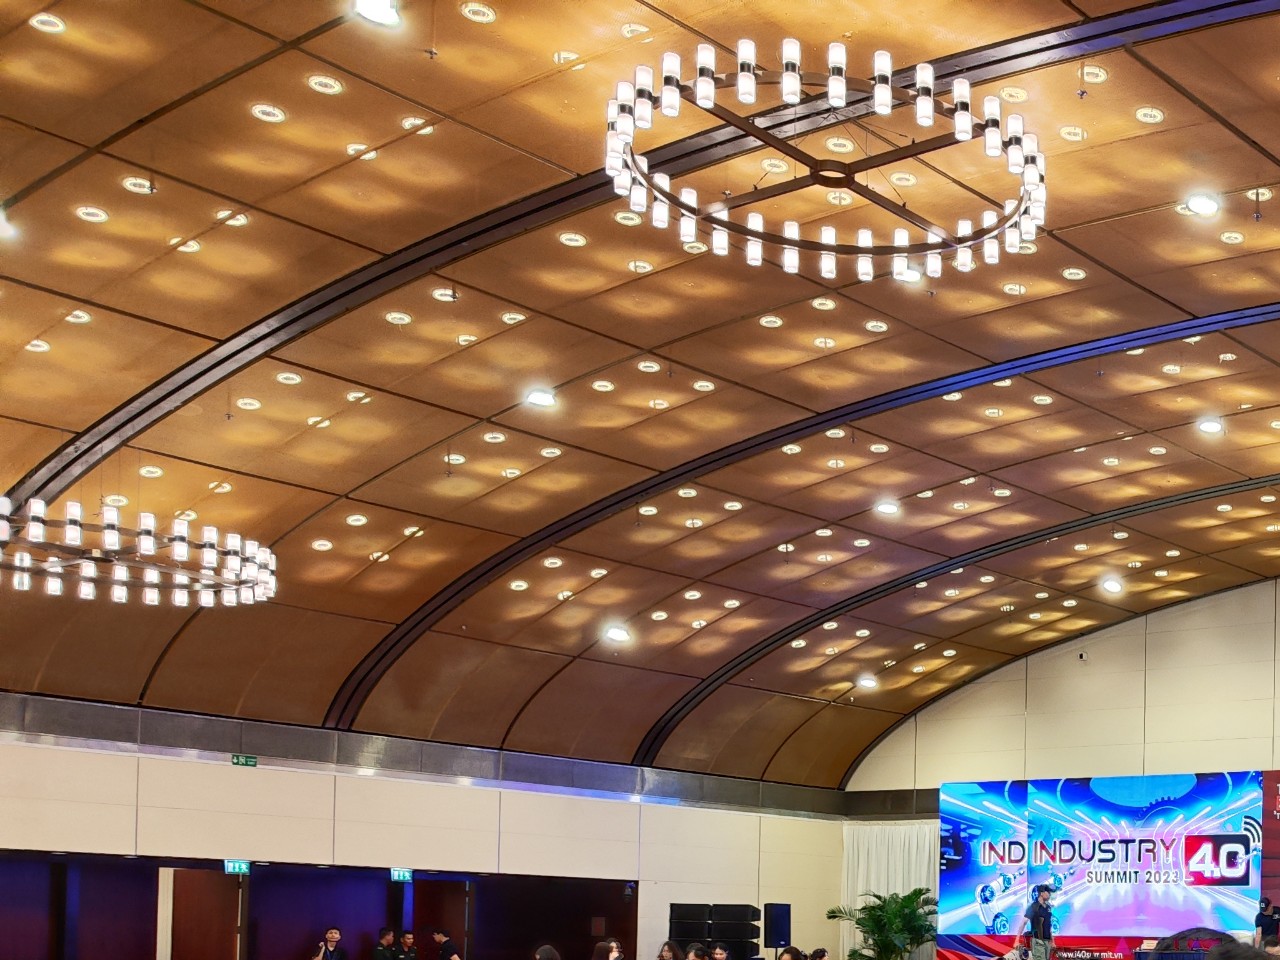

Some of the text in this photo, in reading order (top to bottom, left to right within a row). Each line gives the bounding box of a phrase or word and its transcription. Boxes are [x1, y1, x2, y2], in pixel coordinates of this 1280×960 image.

[982, 840, 1026, 866] IND
[1034, 838, 1247, 879] INDUSTRY 4.0
[1086, 870, 1181, 884] SUMMIT 2023
